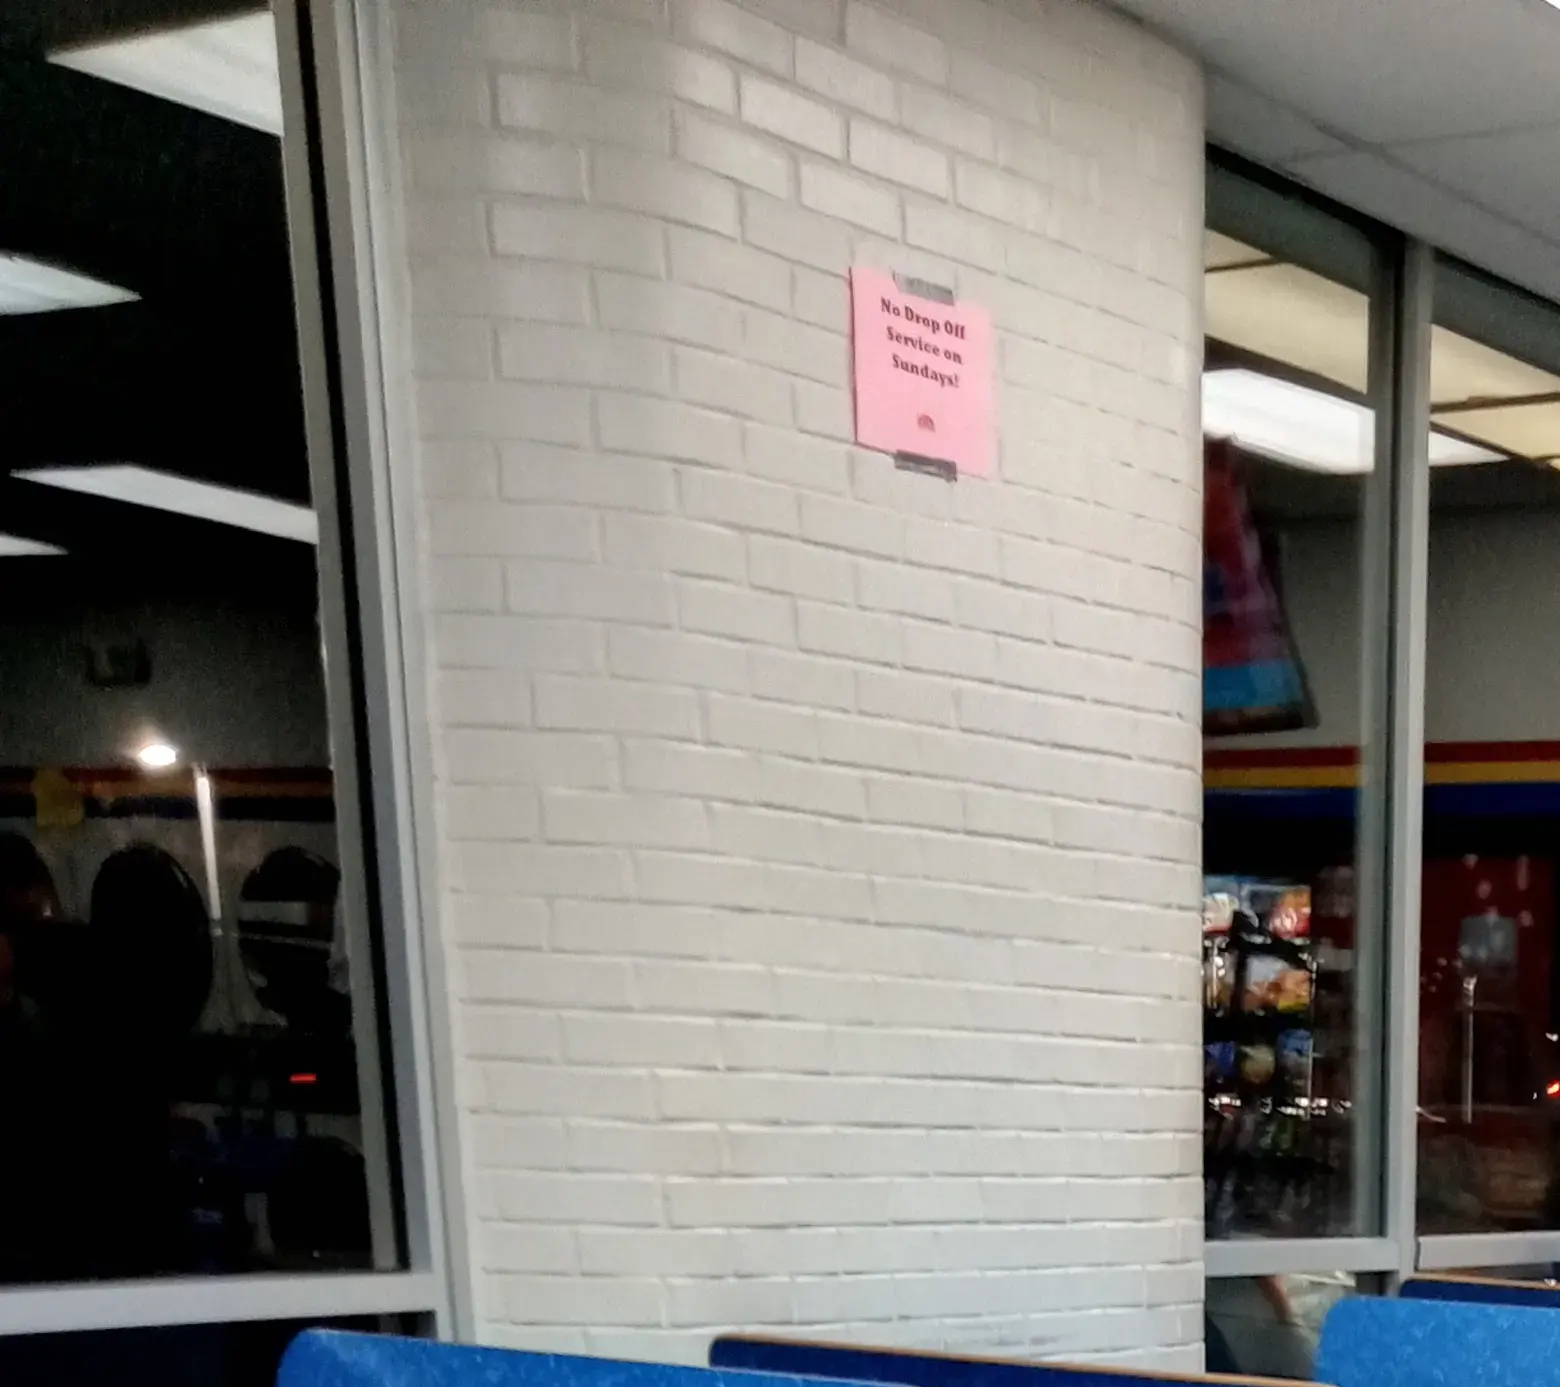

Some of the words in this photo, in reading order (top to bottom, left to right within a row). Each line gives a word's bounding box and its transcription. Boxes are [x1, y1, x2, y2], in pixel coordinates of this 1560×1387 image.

[880, 296, 901, 317] No
[904, 305, 940, 335] Drop
[943, 319, 965, 341] Off
[886, 325, 941, 357] Service
[943, 349, 963, 365] on
[891, 353, 960, 388] Sundays!
